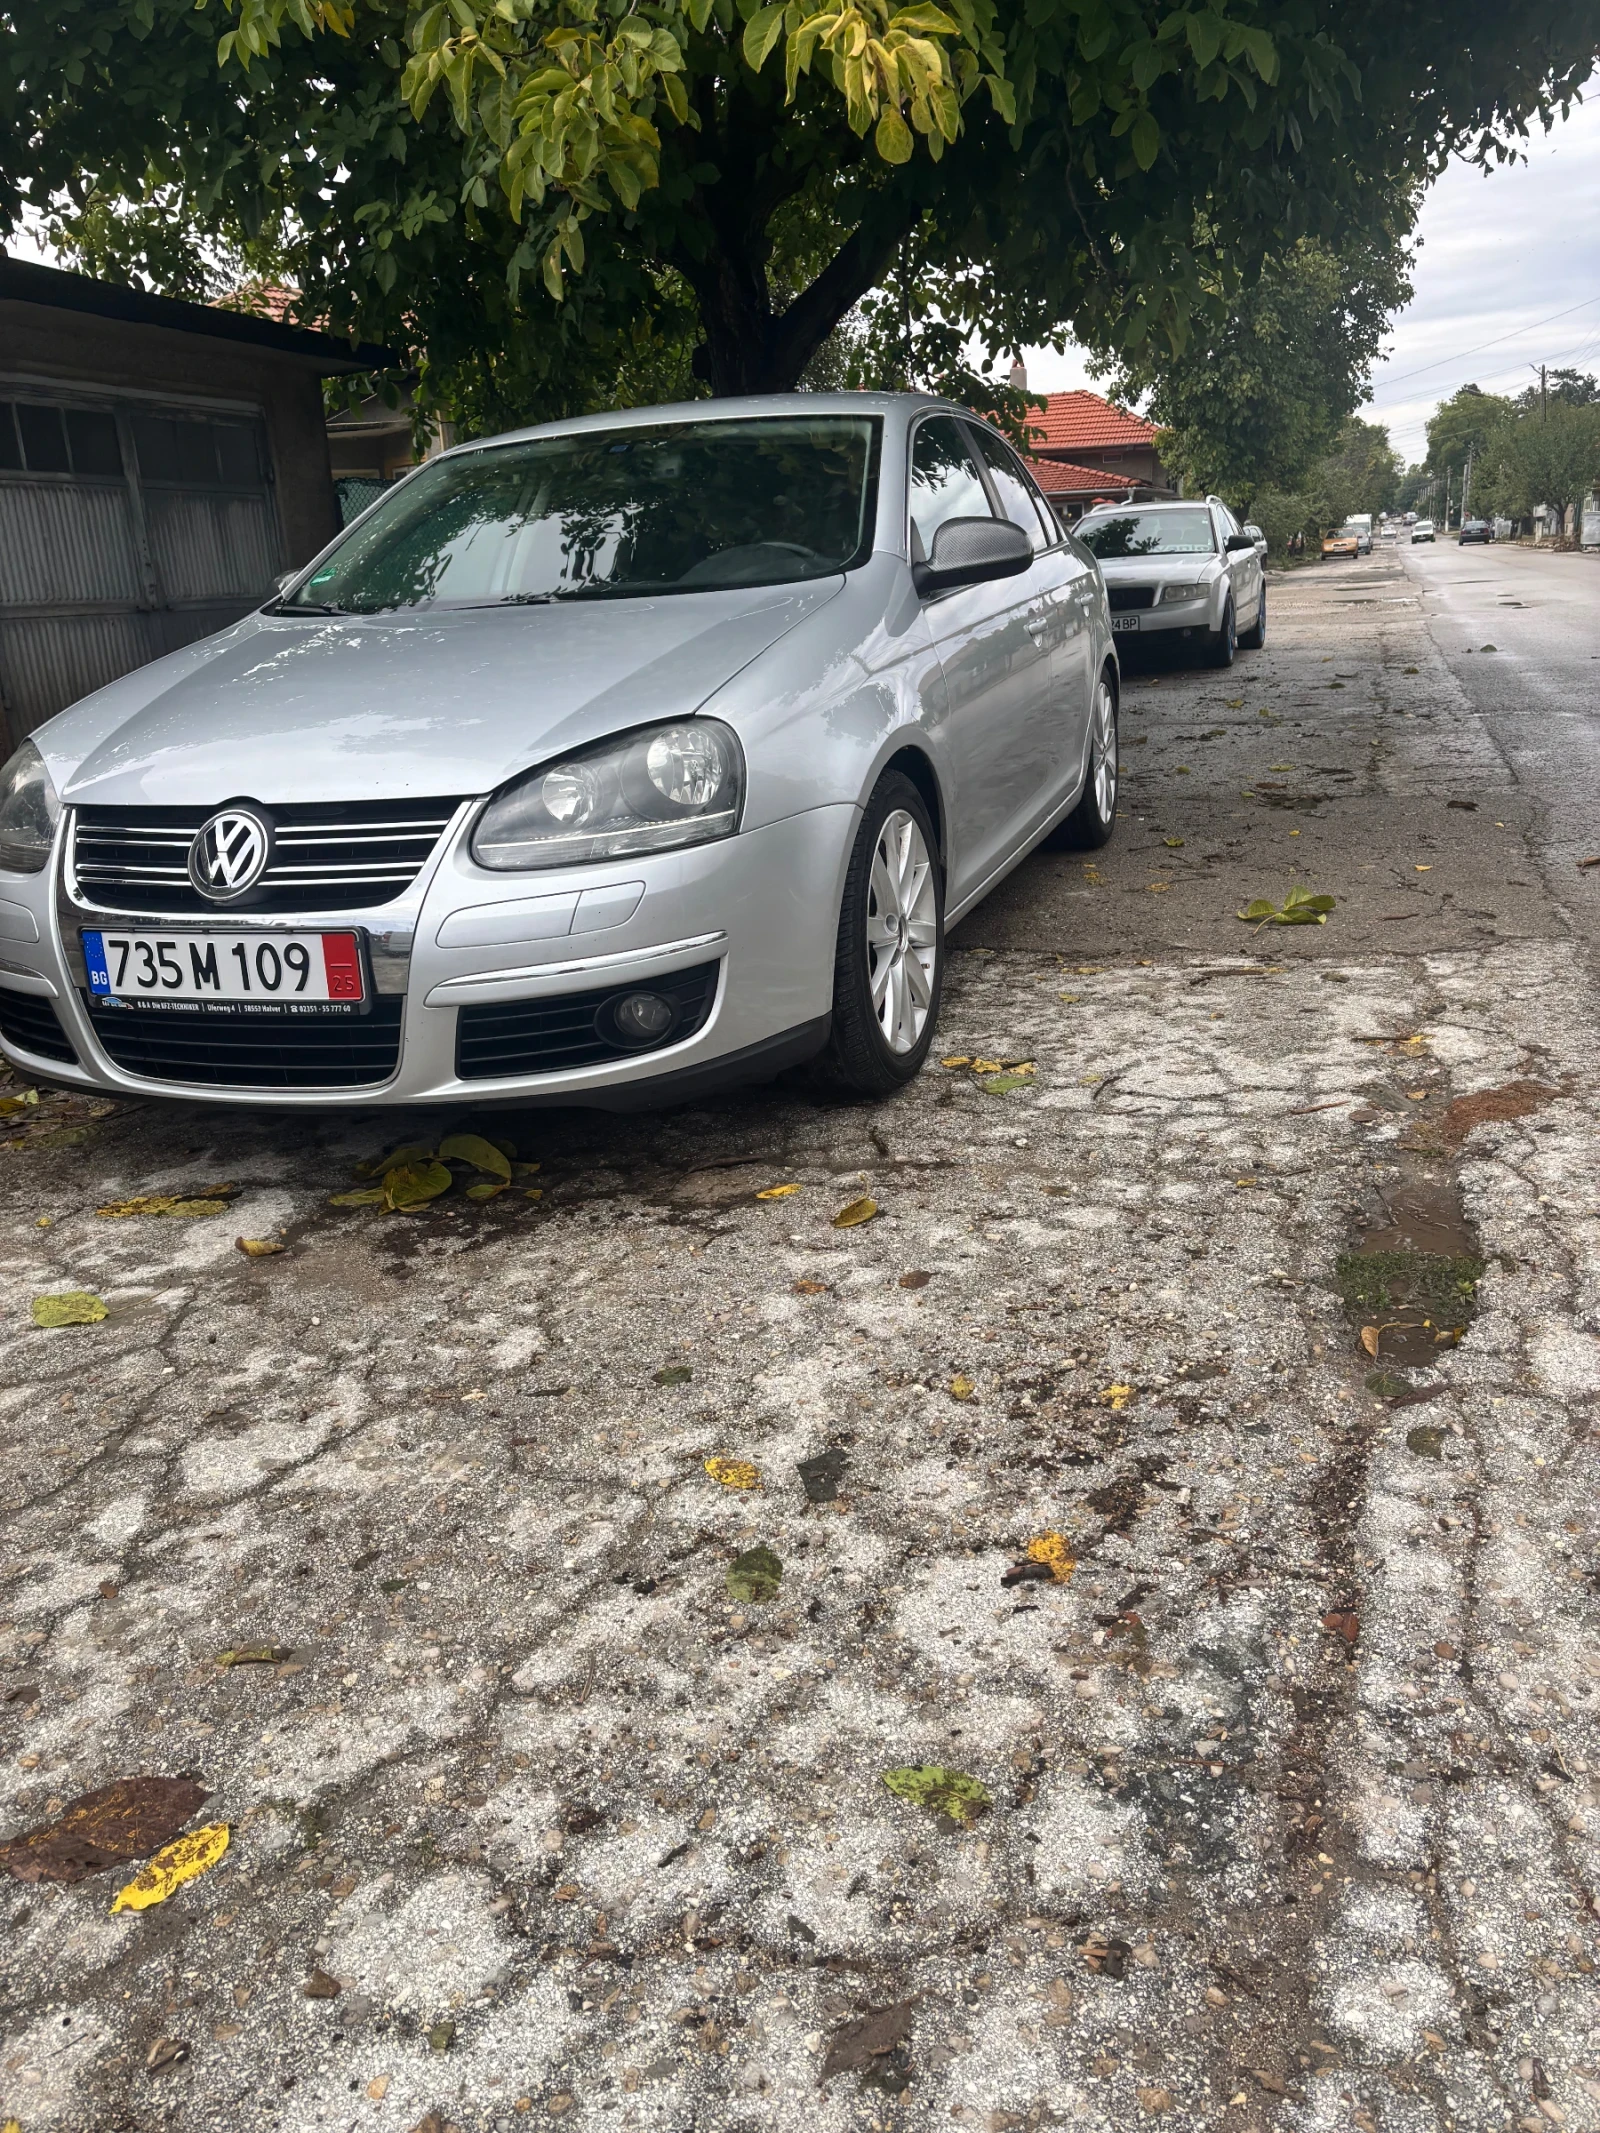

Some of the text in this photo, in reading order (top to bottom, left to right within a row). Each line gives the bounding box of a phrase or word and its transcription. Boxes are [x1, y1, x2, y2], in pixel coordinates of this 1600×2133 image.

[1122, 618, 1137, 630] BP
[108, 939, 311, 992] 735 M 109
[91, 970, 109, 986] BG
[332, 974, 355, 992] 25
